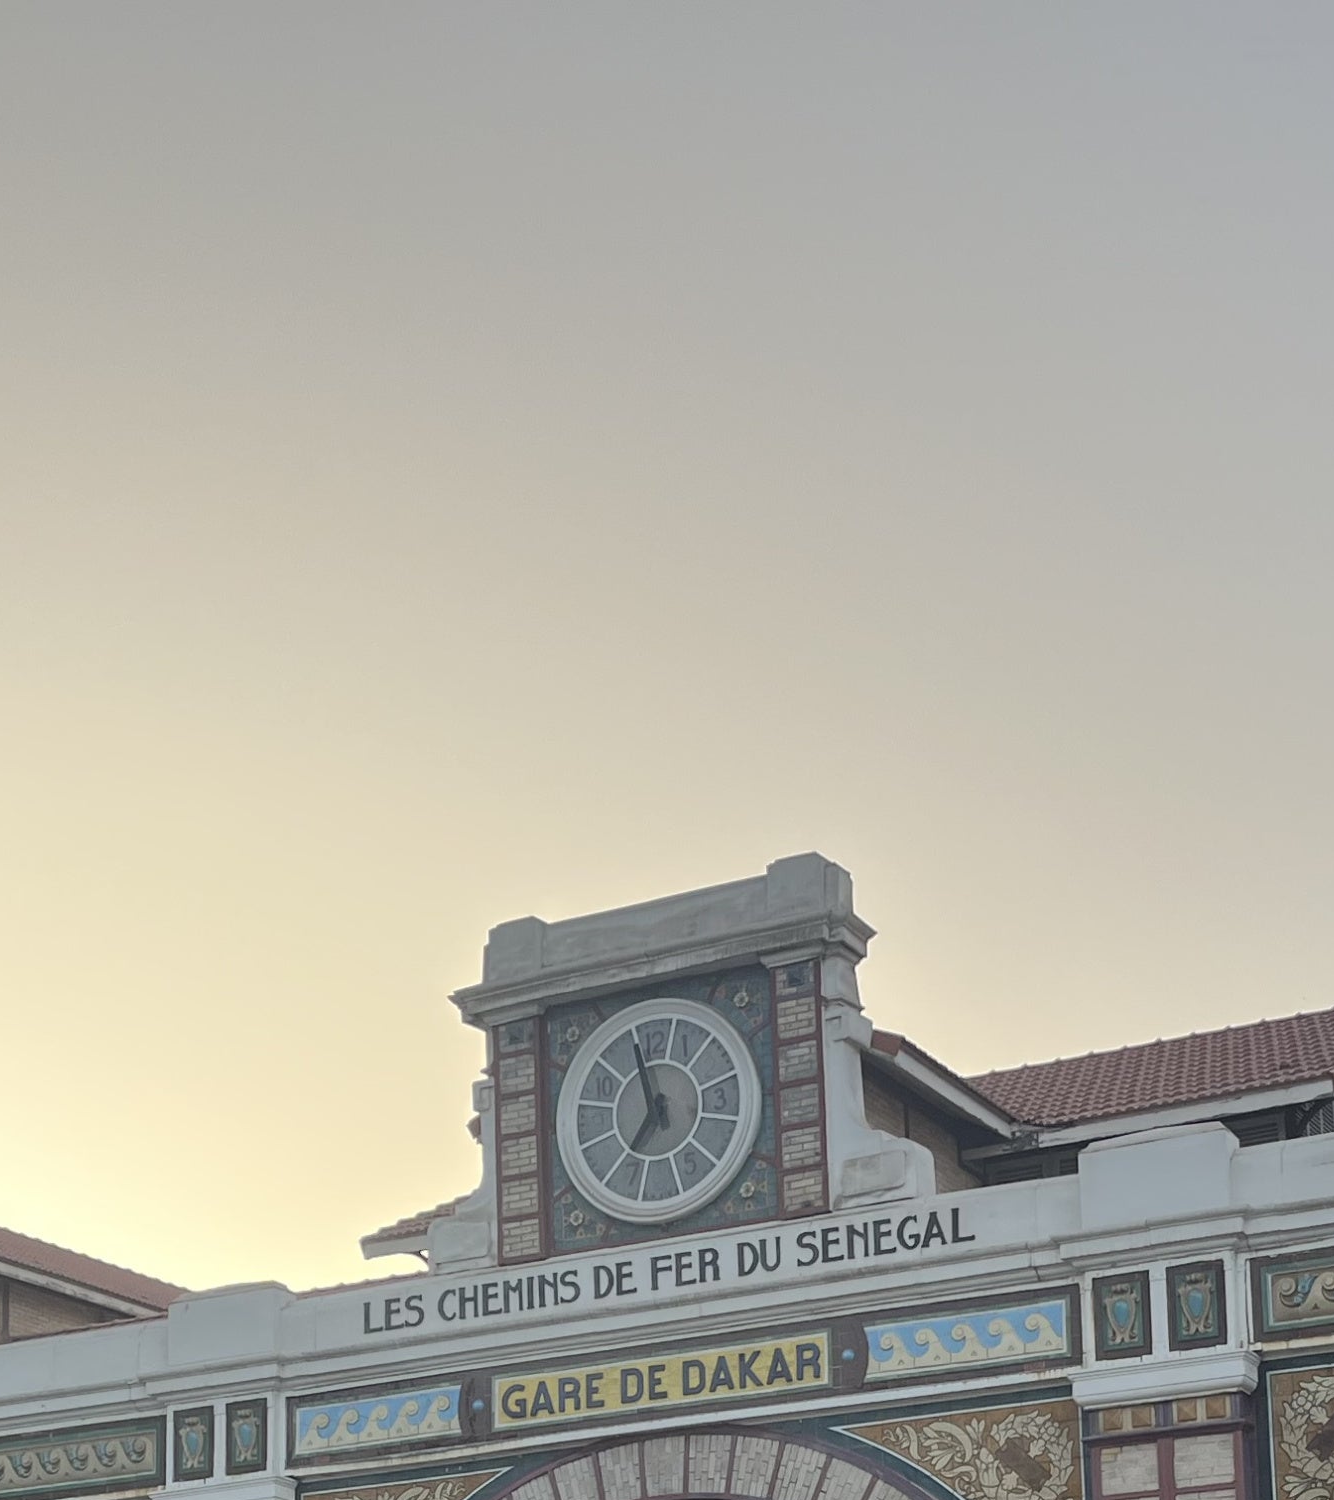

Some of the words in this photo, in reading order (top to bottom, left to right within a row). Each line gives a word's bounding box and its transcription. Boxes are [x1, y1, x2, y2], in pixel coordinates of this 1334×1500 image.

[645, 1030, 665, 1057] 12
[681, 1033, 689, 1057] 1
[596, 1075, 614, 1098] 10
[713, 1087, 727, 1111] 3
[626, 1162, 641, 1187] 7
[683, 1151, 697, 1175] 5
[363, 1294, 425, 1334] LES
[436, 1269, 581, 1322] CHEMINS
[593, 1260, 637, 1300] DE
[650, 1247, 721, 1291] FER
[736, 1236, 781, 1277] DU
[796, 1207, 976, 1267] SENEGAL
[501, 1372, 605, 1419] GARE
[620, 1364, 666, 1405] DE
[681, 1342, 822, 1396] DAKAR
